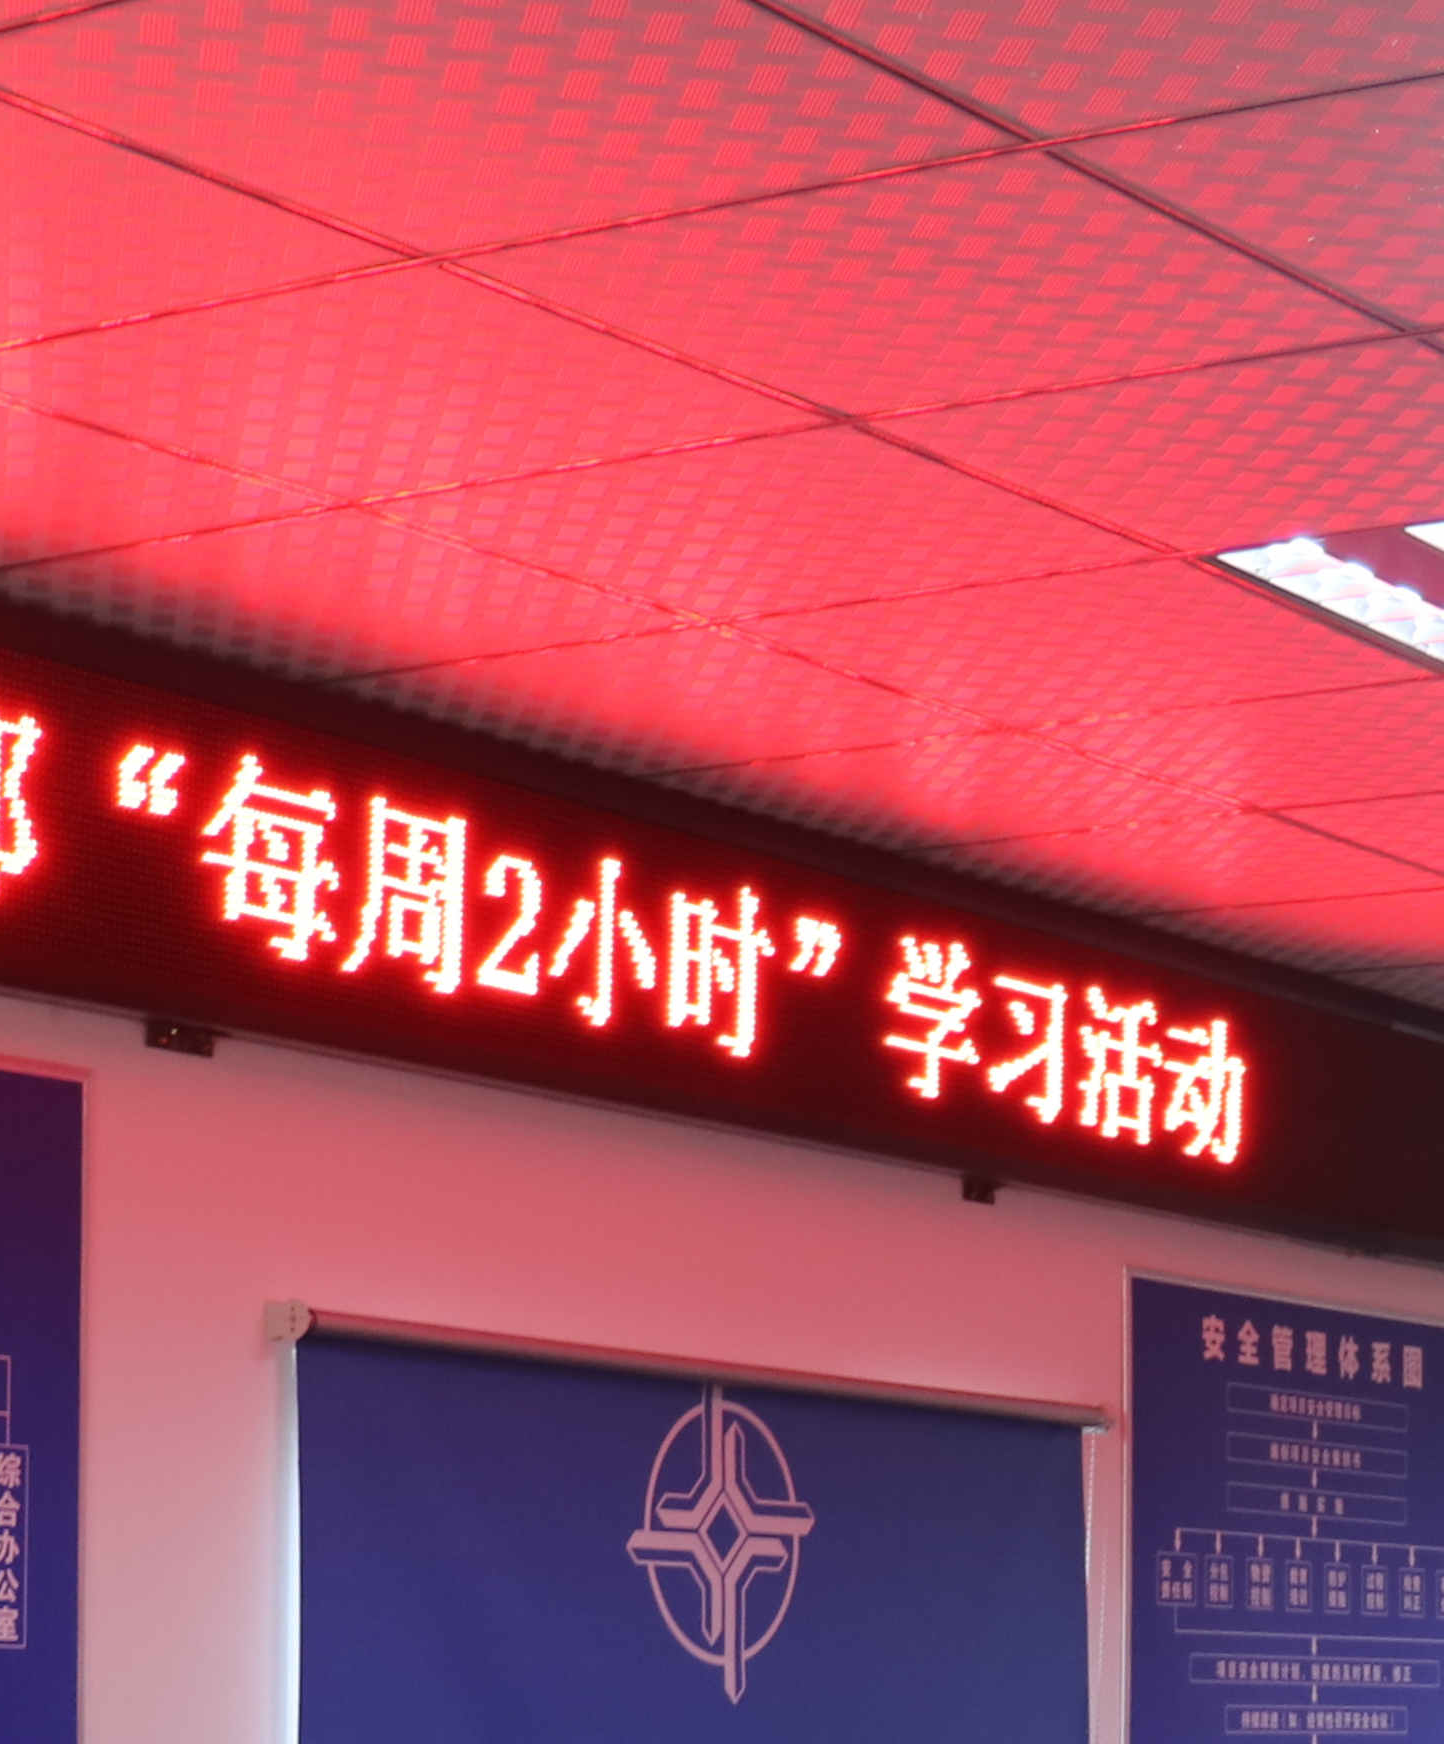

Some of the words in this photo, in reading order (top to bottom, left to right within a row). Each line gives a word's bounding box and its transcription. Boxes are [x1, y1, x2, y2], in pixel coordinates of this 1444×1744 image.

[1201, 1314, 1423, 1390] 安全管理体系图
